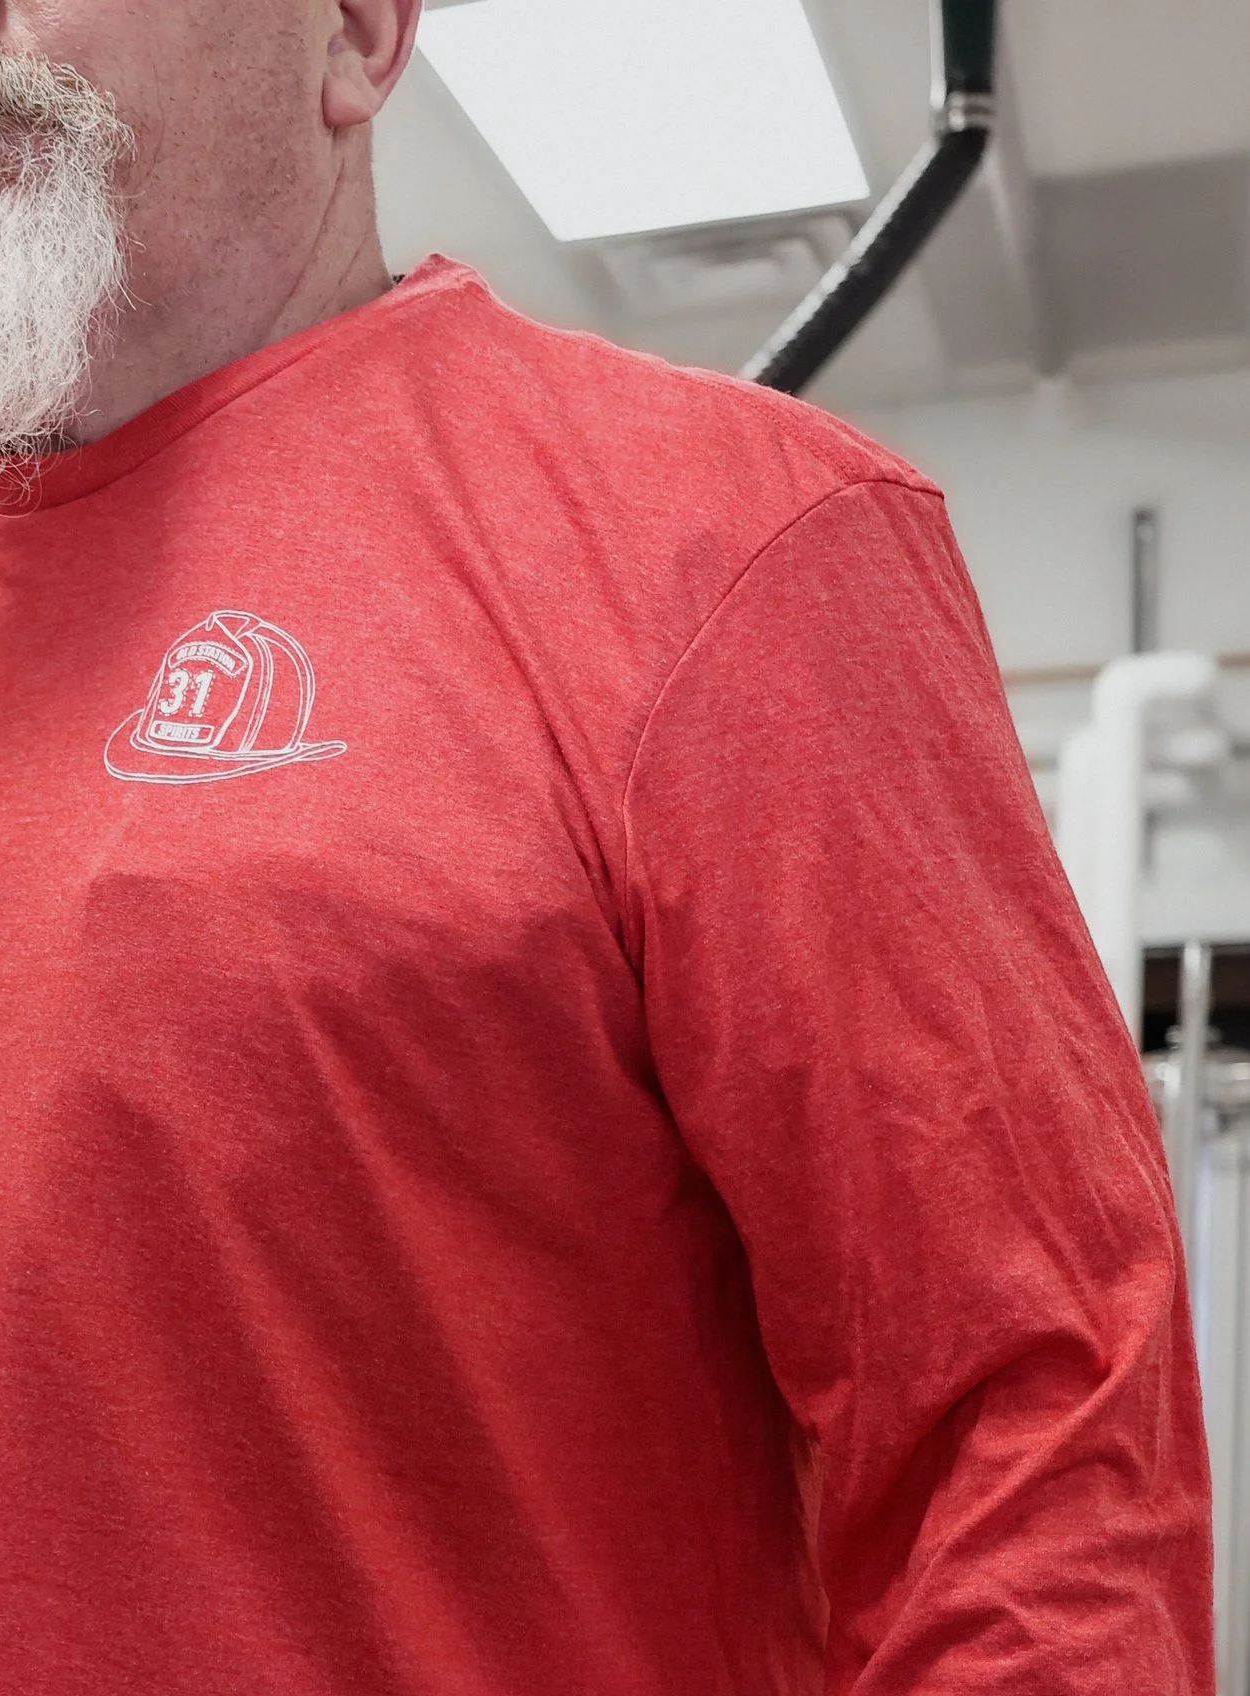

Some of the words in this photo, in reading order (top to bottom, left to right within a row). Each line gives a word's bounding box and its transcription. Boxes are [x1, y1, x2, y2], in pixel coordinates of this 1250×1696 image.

[197, 646, 236, 671] STATION
[160, 670, 213, 714] 31
[159, 724, 200, 739] SPIRITS
